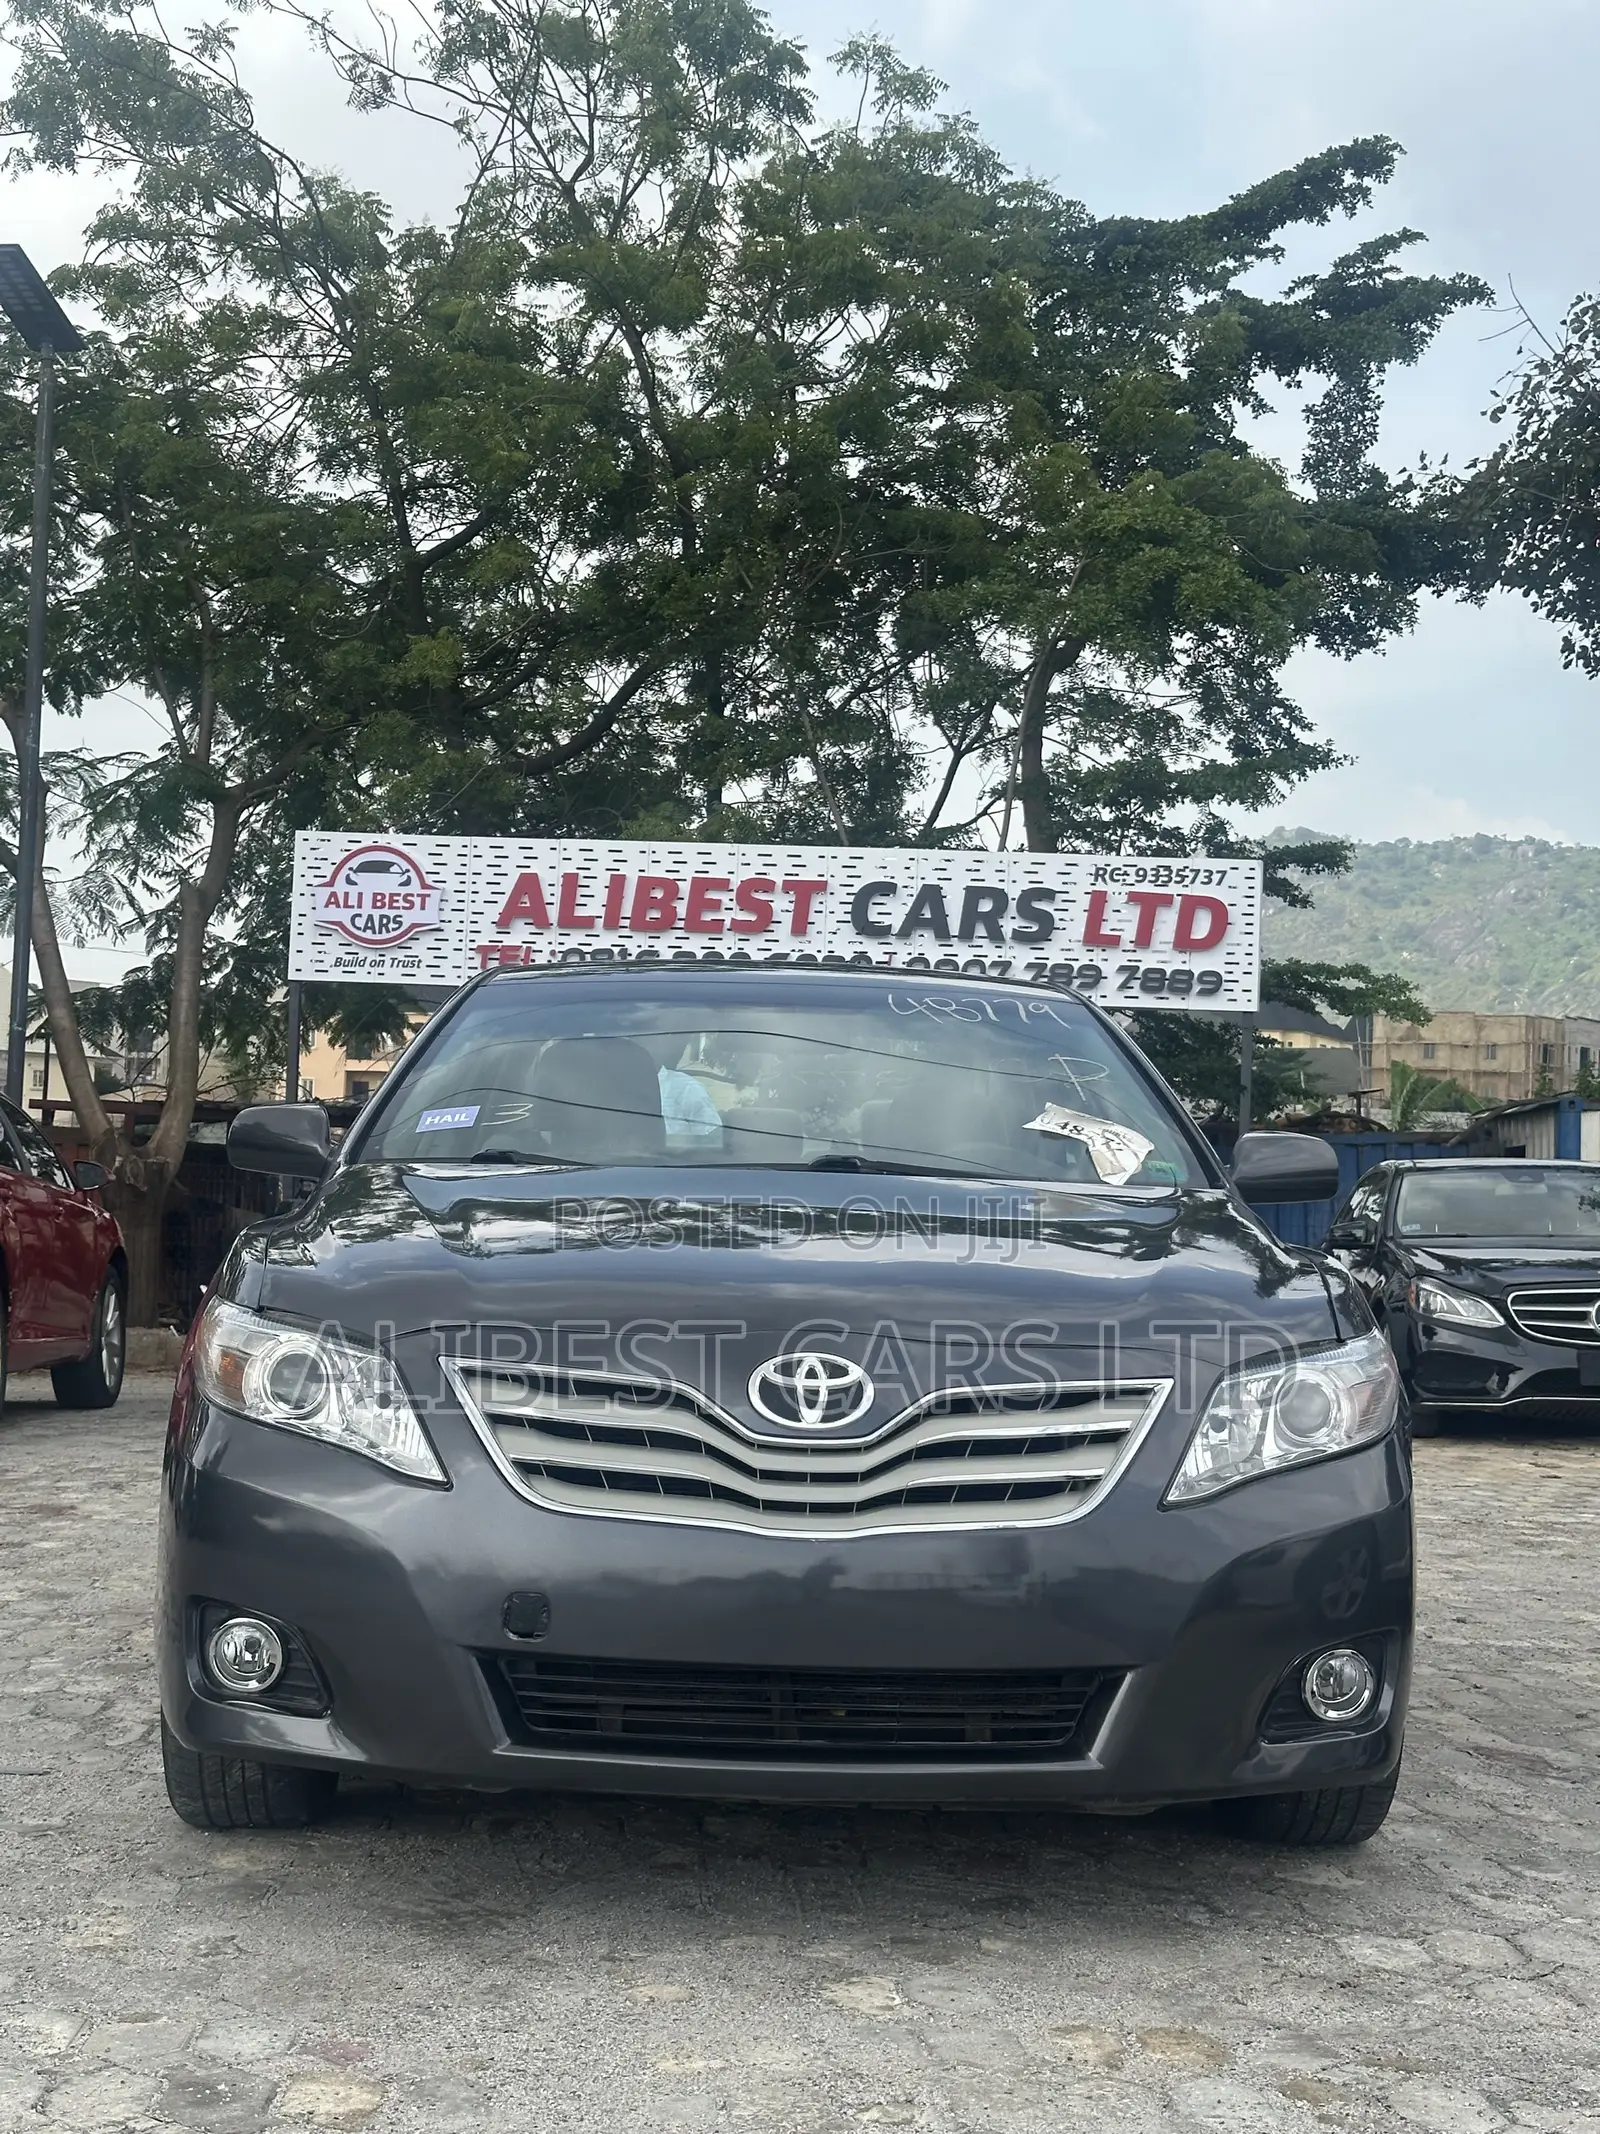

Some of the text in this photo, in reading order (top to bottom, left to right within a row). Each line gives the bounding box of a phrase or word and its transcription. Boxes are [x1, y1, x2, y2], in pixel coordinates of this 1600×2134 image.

[1134, 866, 1228, 887] 9335737
[323, 891, 431, 911] ALI BEST
[494, 872, 1229, 952] ALIBEST CARS LTD
[350, 913, 404, 935] CARS
[333, 956, 423, 969] Build on Trust
[1115, 964, 1224, 995] 7889
[425, 1112, 470, 1125] HAIL
